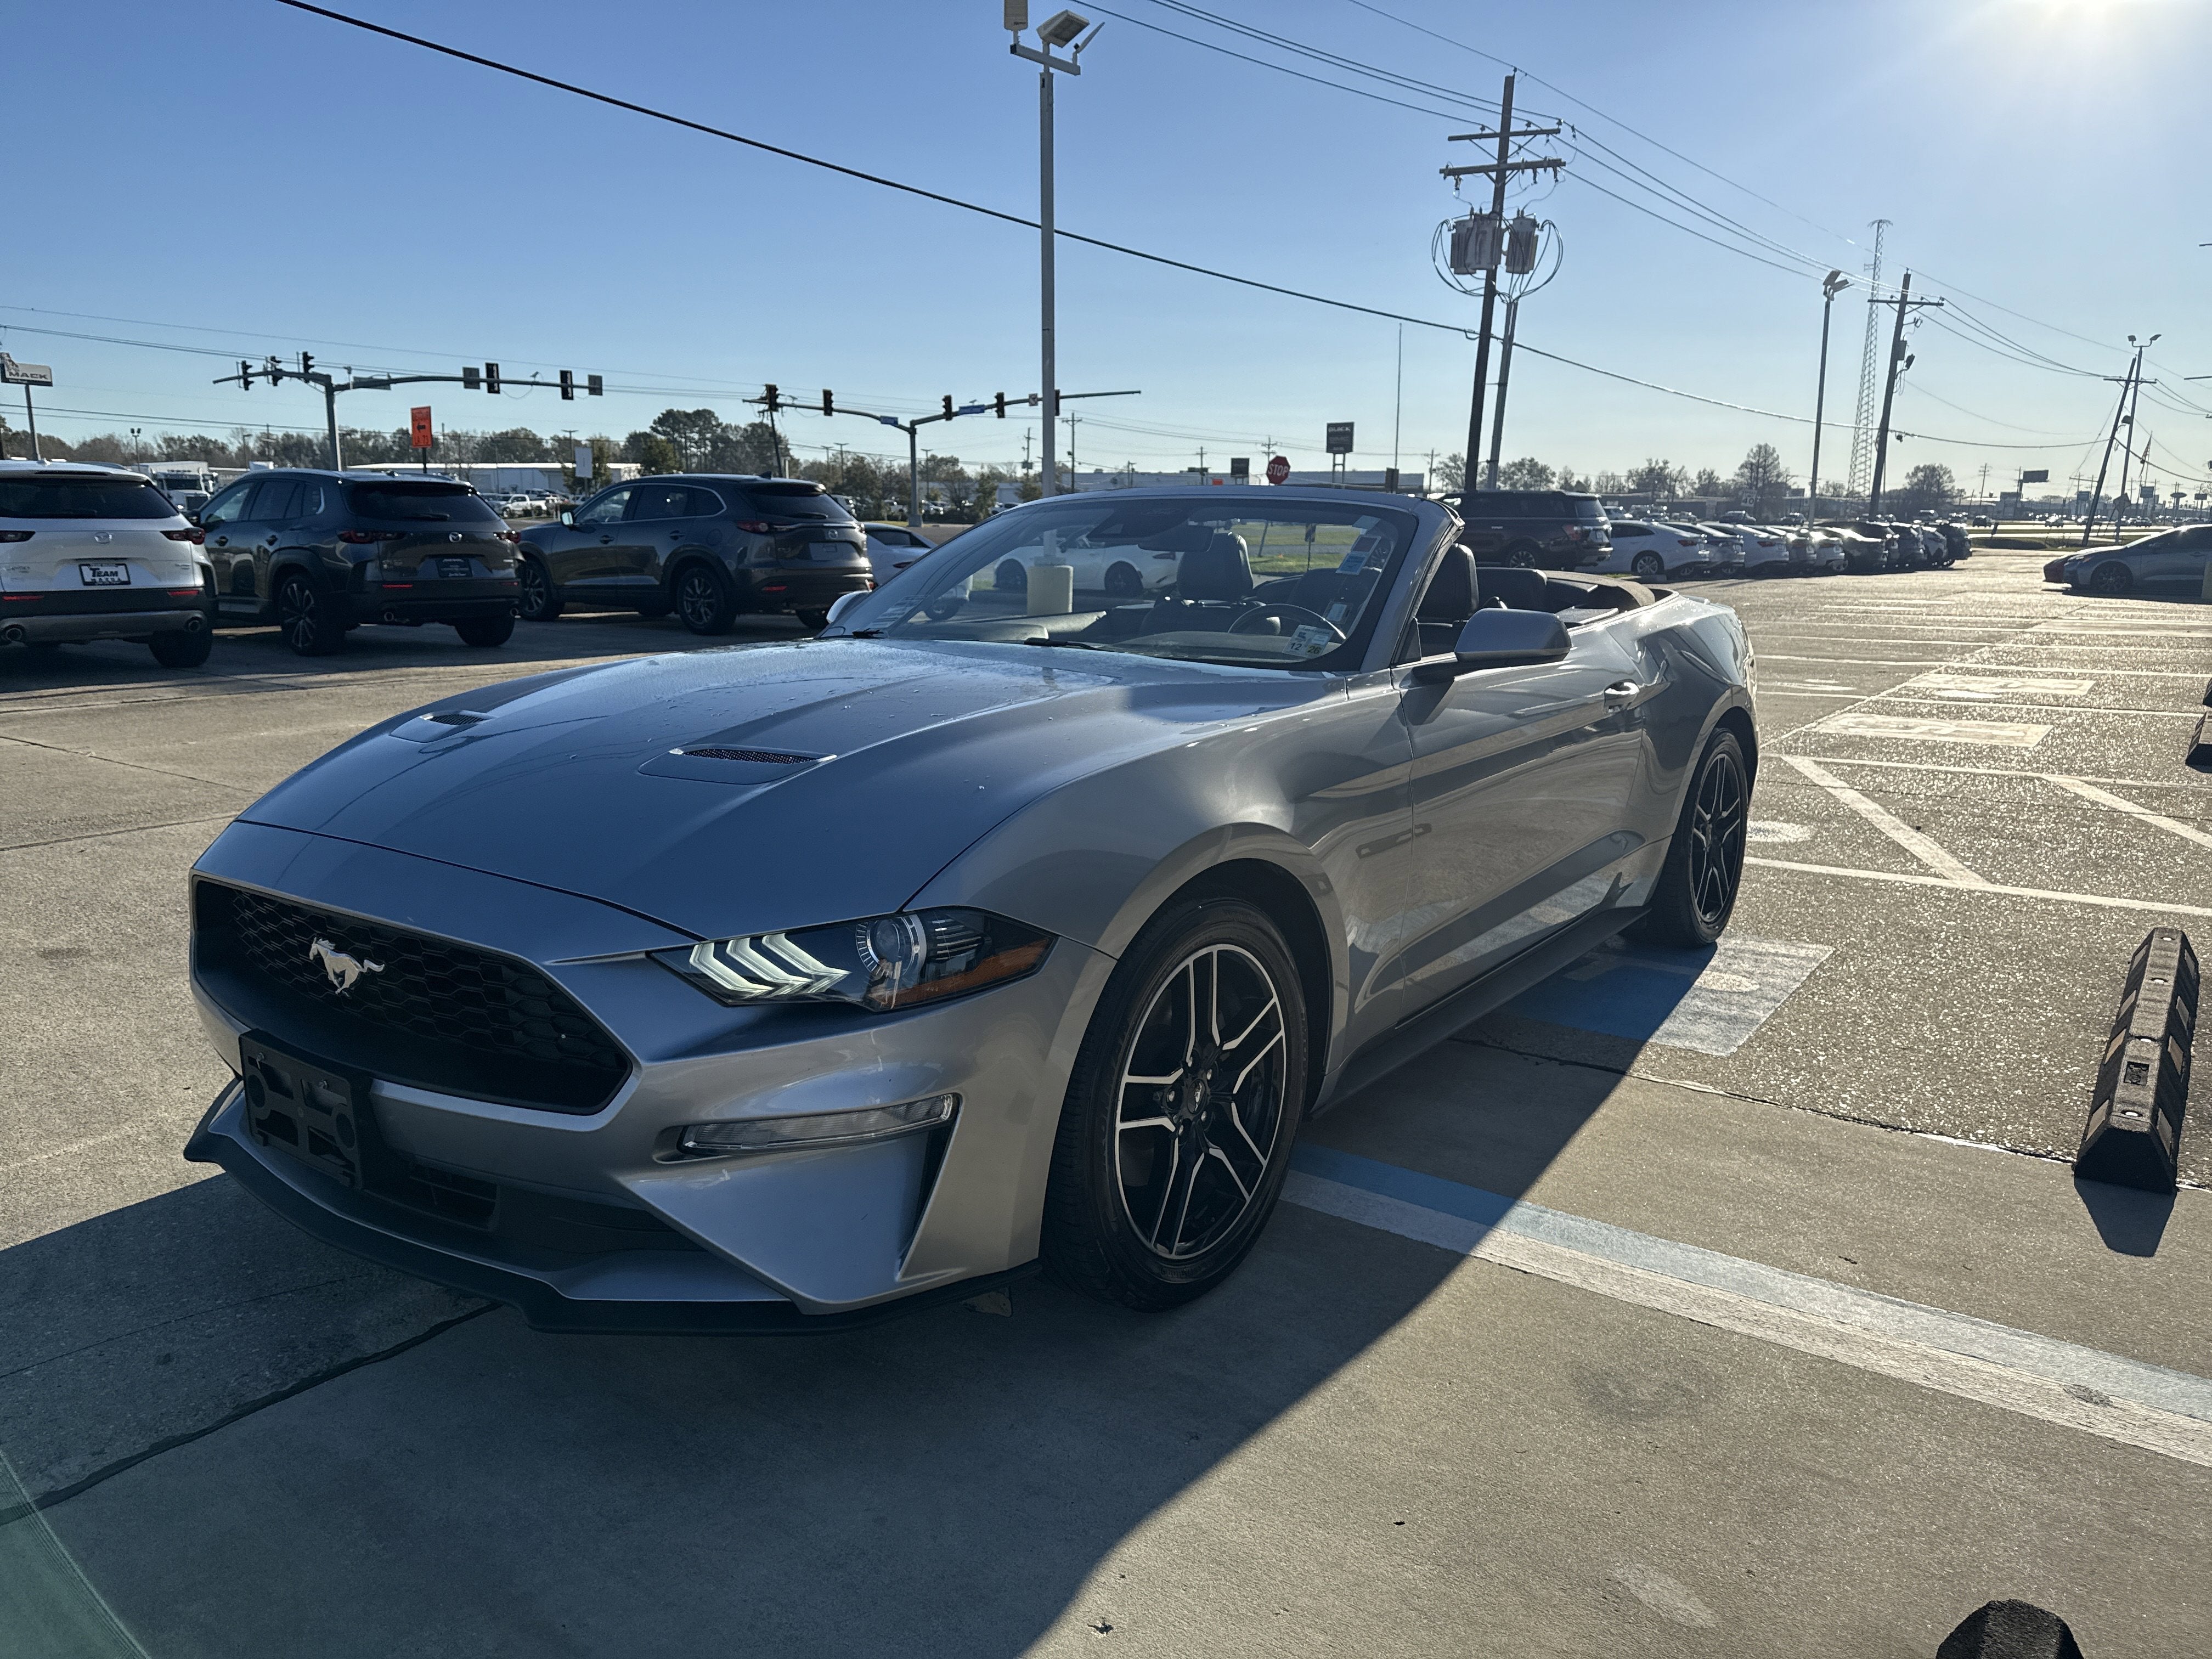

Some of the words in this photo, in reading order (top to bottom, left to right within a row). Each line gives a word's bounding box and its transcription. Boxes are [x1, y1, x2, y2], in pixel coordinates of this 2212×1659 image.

[1268, 464, 1289, 476] STOP
[89, 568, 119, 578] TEAM
[1290, 642, 1302, 651] 12
[1307, 646, 1322, 654] 26
